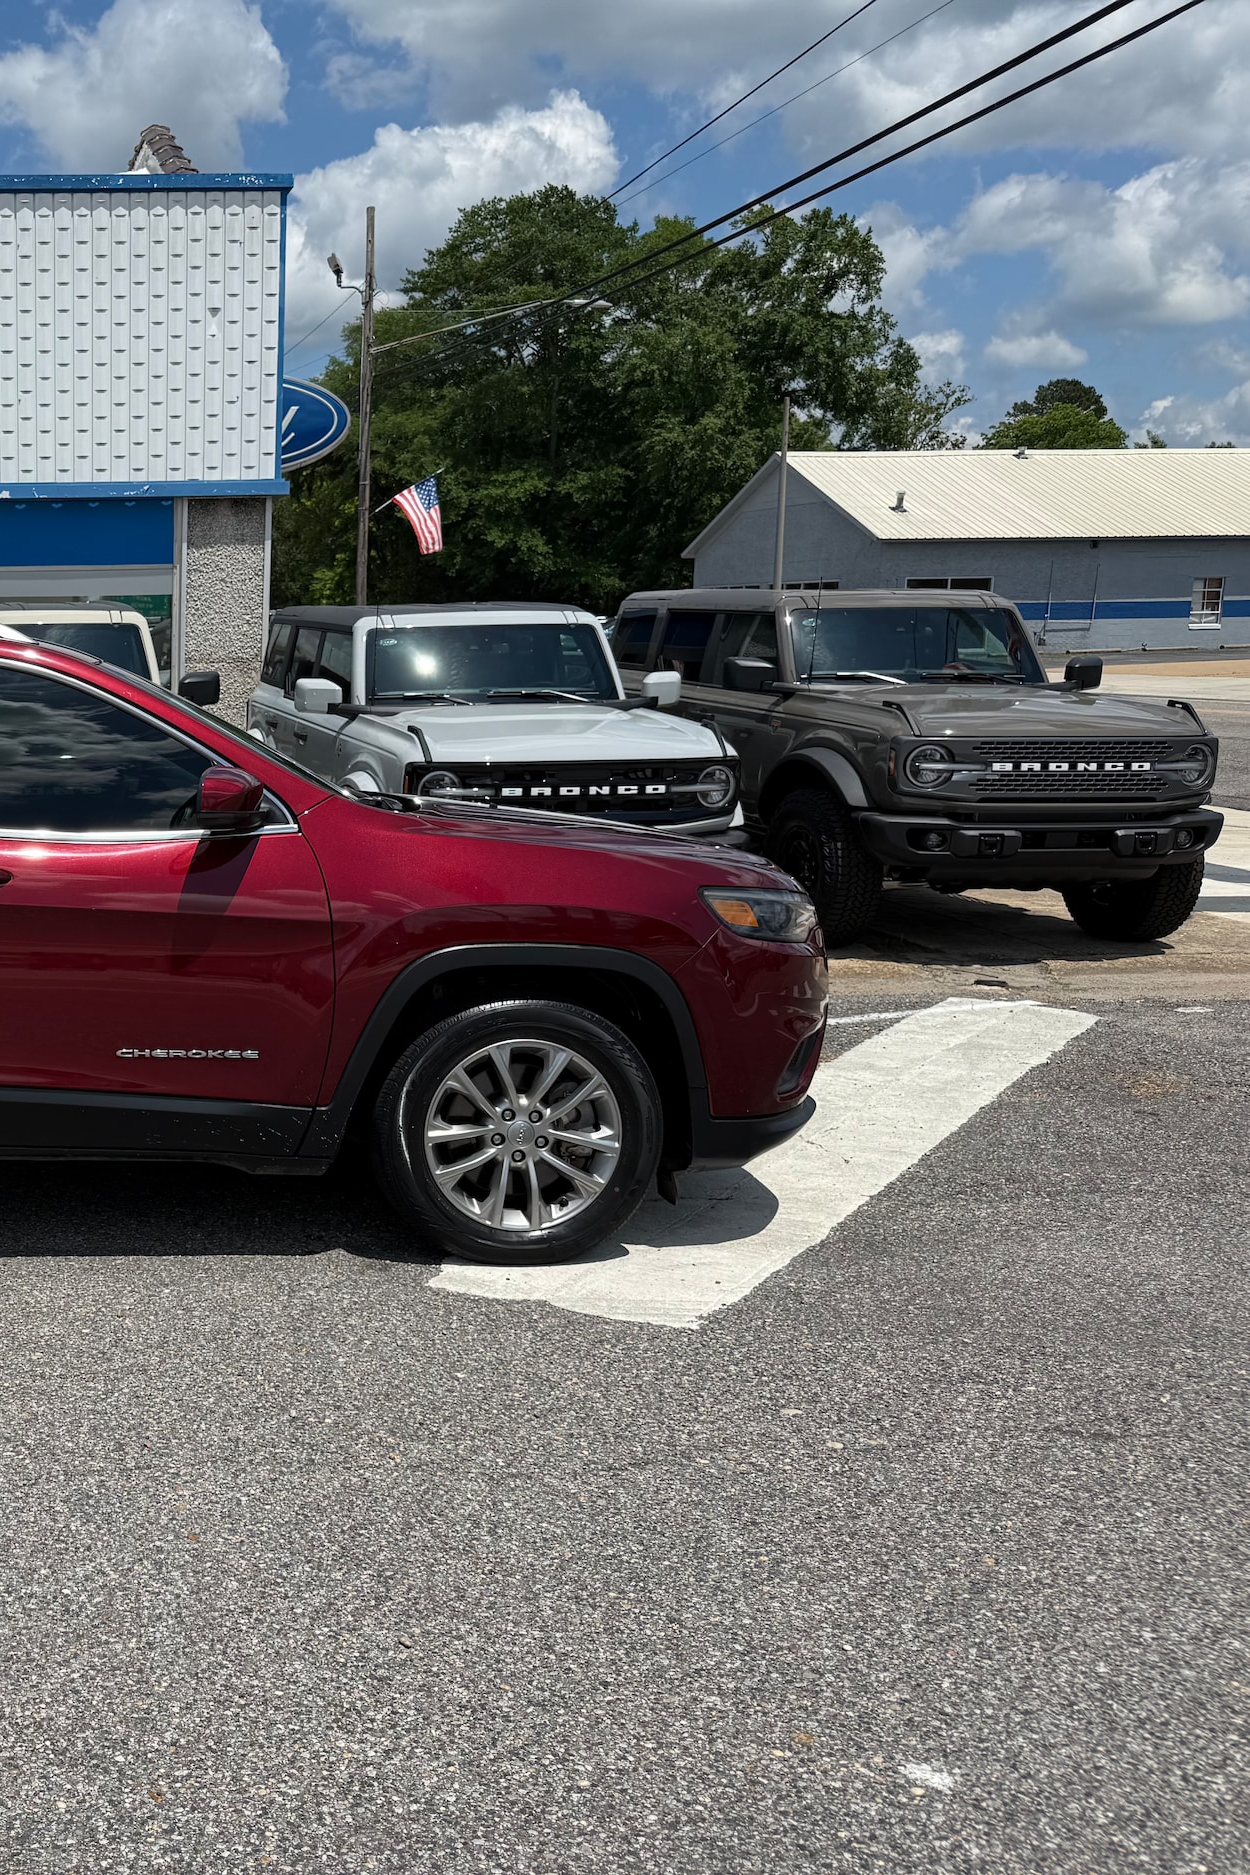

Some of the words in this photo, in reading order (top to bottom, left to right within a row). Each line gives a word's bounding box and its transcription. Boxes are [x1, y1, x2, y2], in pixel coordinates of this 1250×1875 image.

[991, 762, 1151, 772] BRONCO
[501, 784, 667, 797] BRONCO
[116, 1048, 260, 1059] CHEROKEE
